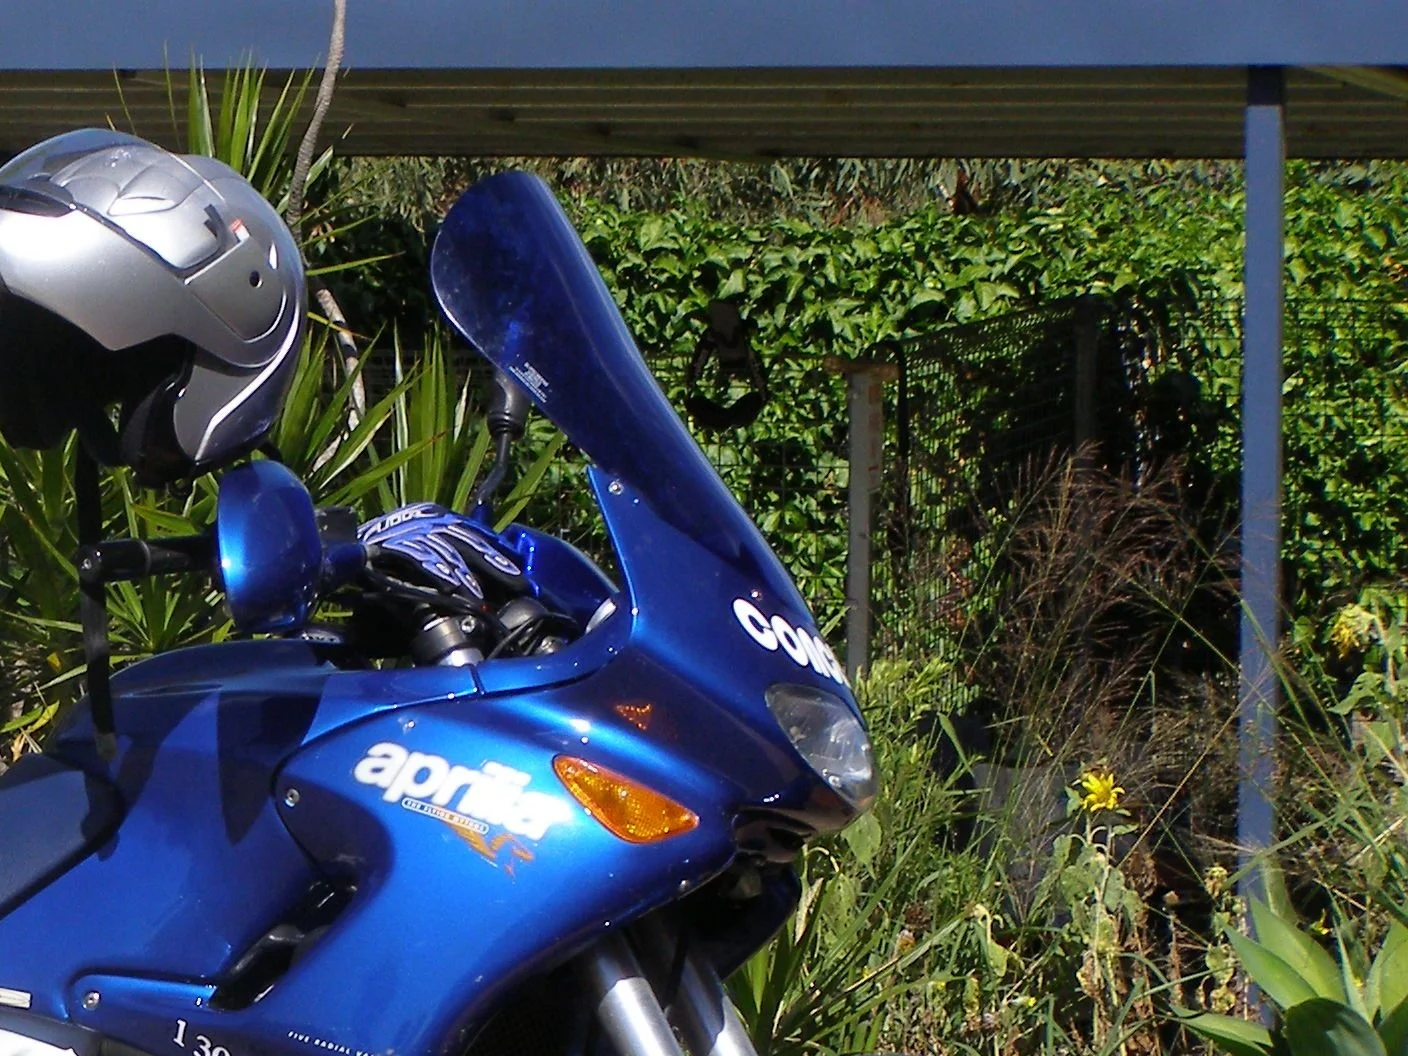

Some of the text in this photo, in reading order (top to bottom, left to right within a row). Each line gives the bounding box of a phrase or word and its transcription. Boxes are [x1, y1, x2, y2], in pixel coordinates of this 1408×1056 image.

[354, 742, 574, 841] aprilia
[172, 1018, 187, 1048] 1
[313, 1038, 351, 1056] RADIAL
